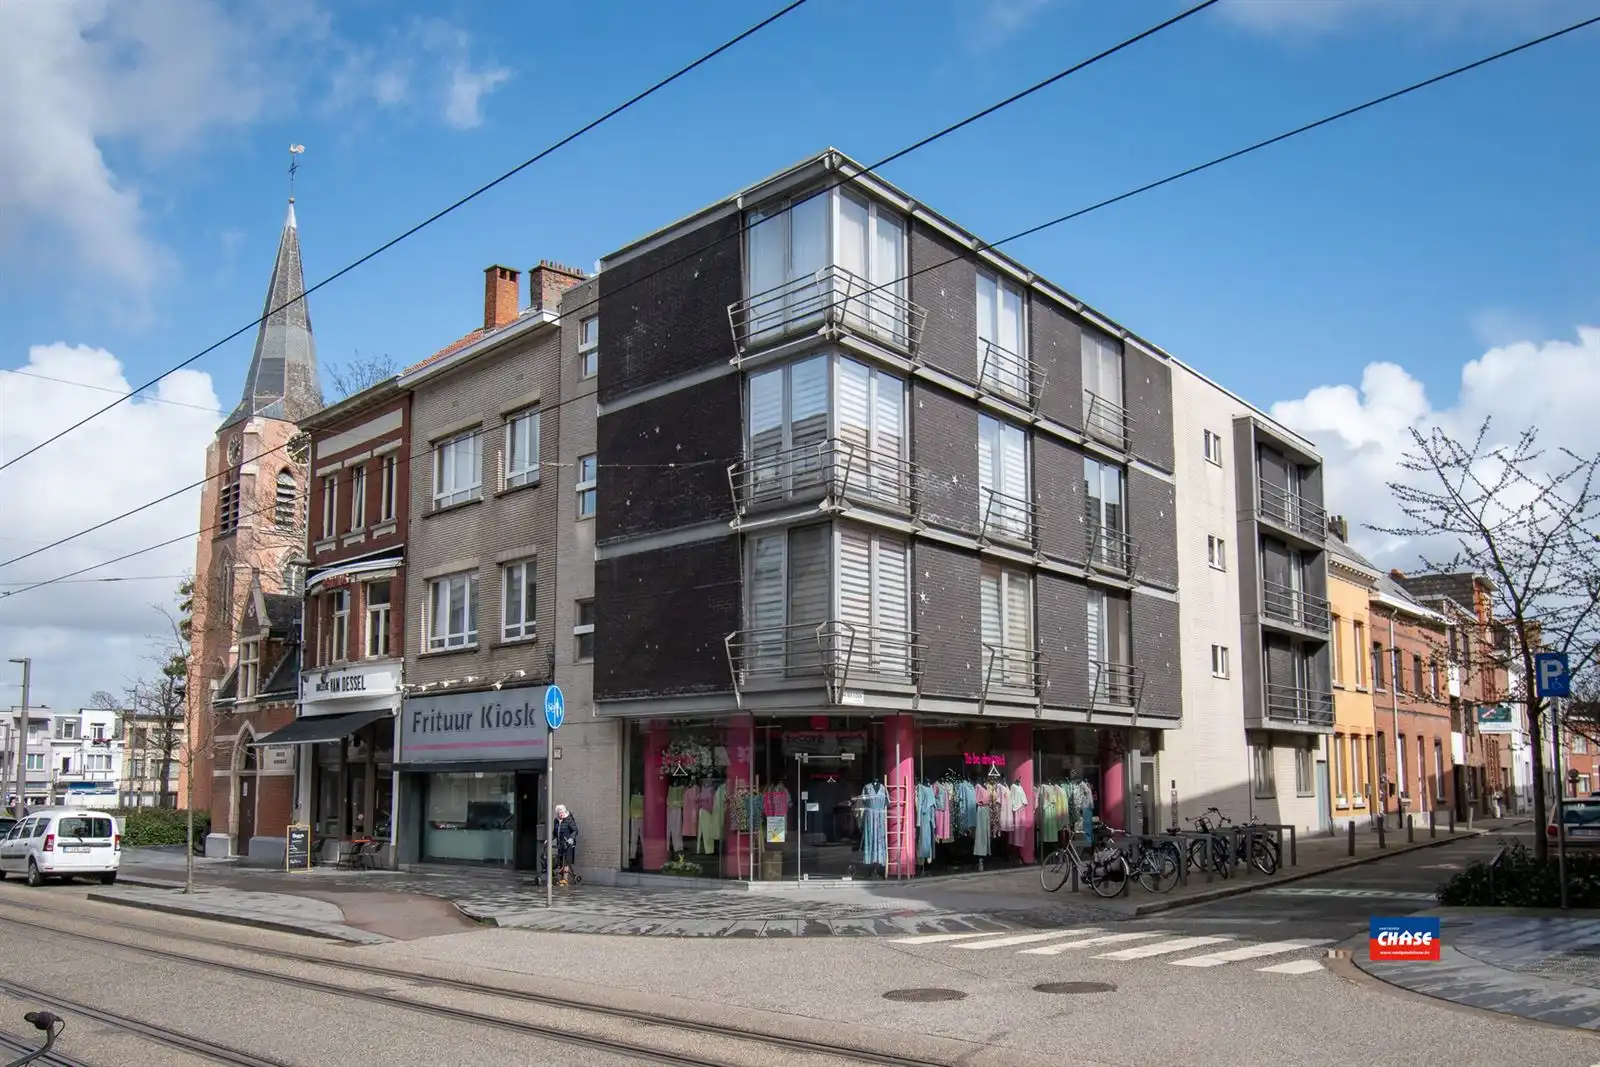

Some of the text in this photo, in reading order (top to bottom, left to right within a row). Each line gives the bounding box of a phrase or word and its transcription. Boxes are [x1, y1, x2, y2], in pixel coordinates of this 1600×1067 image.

[330, 677, 341, 692] VAN
[342, 675, 366, 691] DESSEL
[1540, 659, 1563, 690] P
[412, 702, 537, 733] Frituur Kiosk
